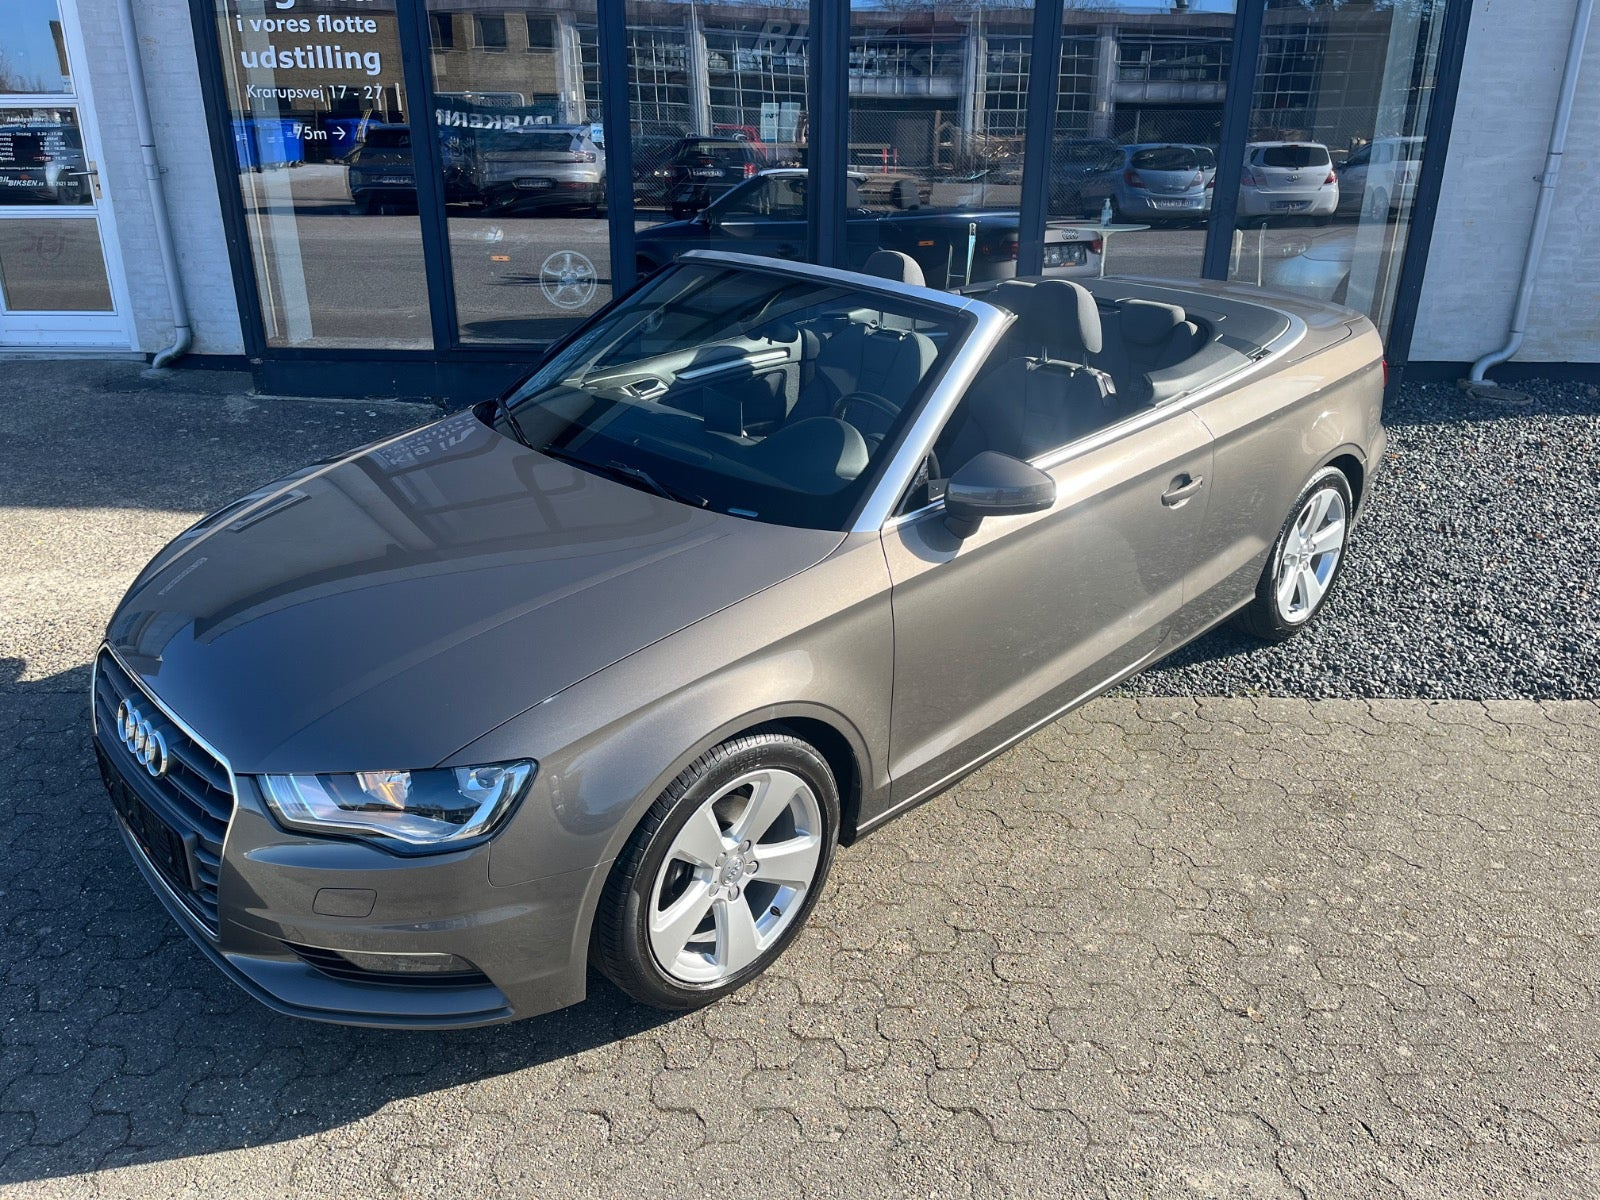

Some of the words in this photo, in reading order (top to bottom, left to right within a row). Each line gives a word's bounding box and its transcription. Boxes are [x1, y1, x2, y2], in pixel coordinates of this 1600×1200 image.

[236, 15, 243, 32] i
[250, 17, 311, 32] vores
[316, 15, 377, 32] flotte
[241, 45, 381, 75] udstilling
[246, 84, 325, 102] Krarupsvej
[329, 85, 346, 99] 17
[365, 85, 382, 99] 27
[295, 126, 327, 140] 75m
